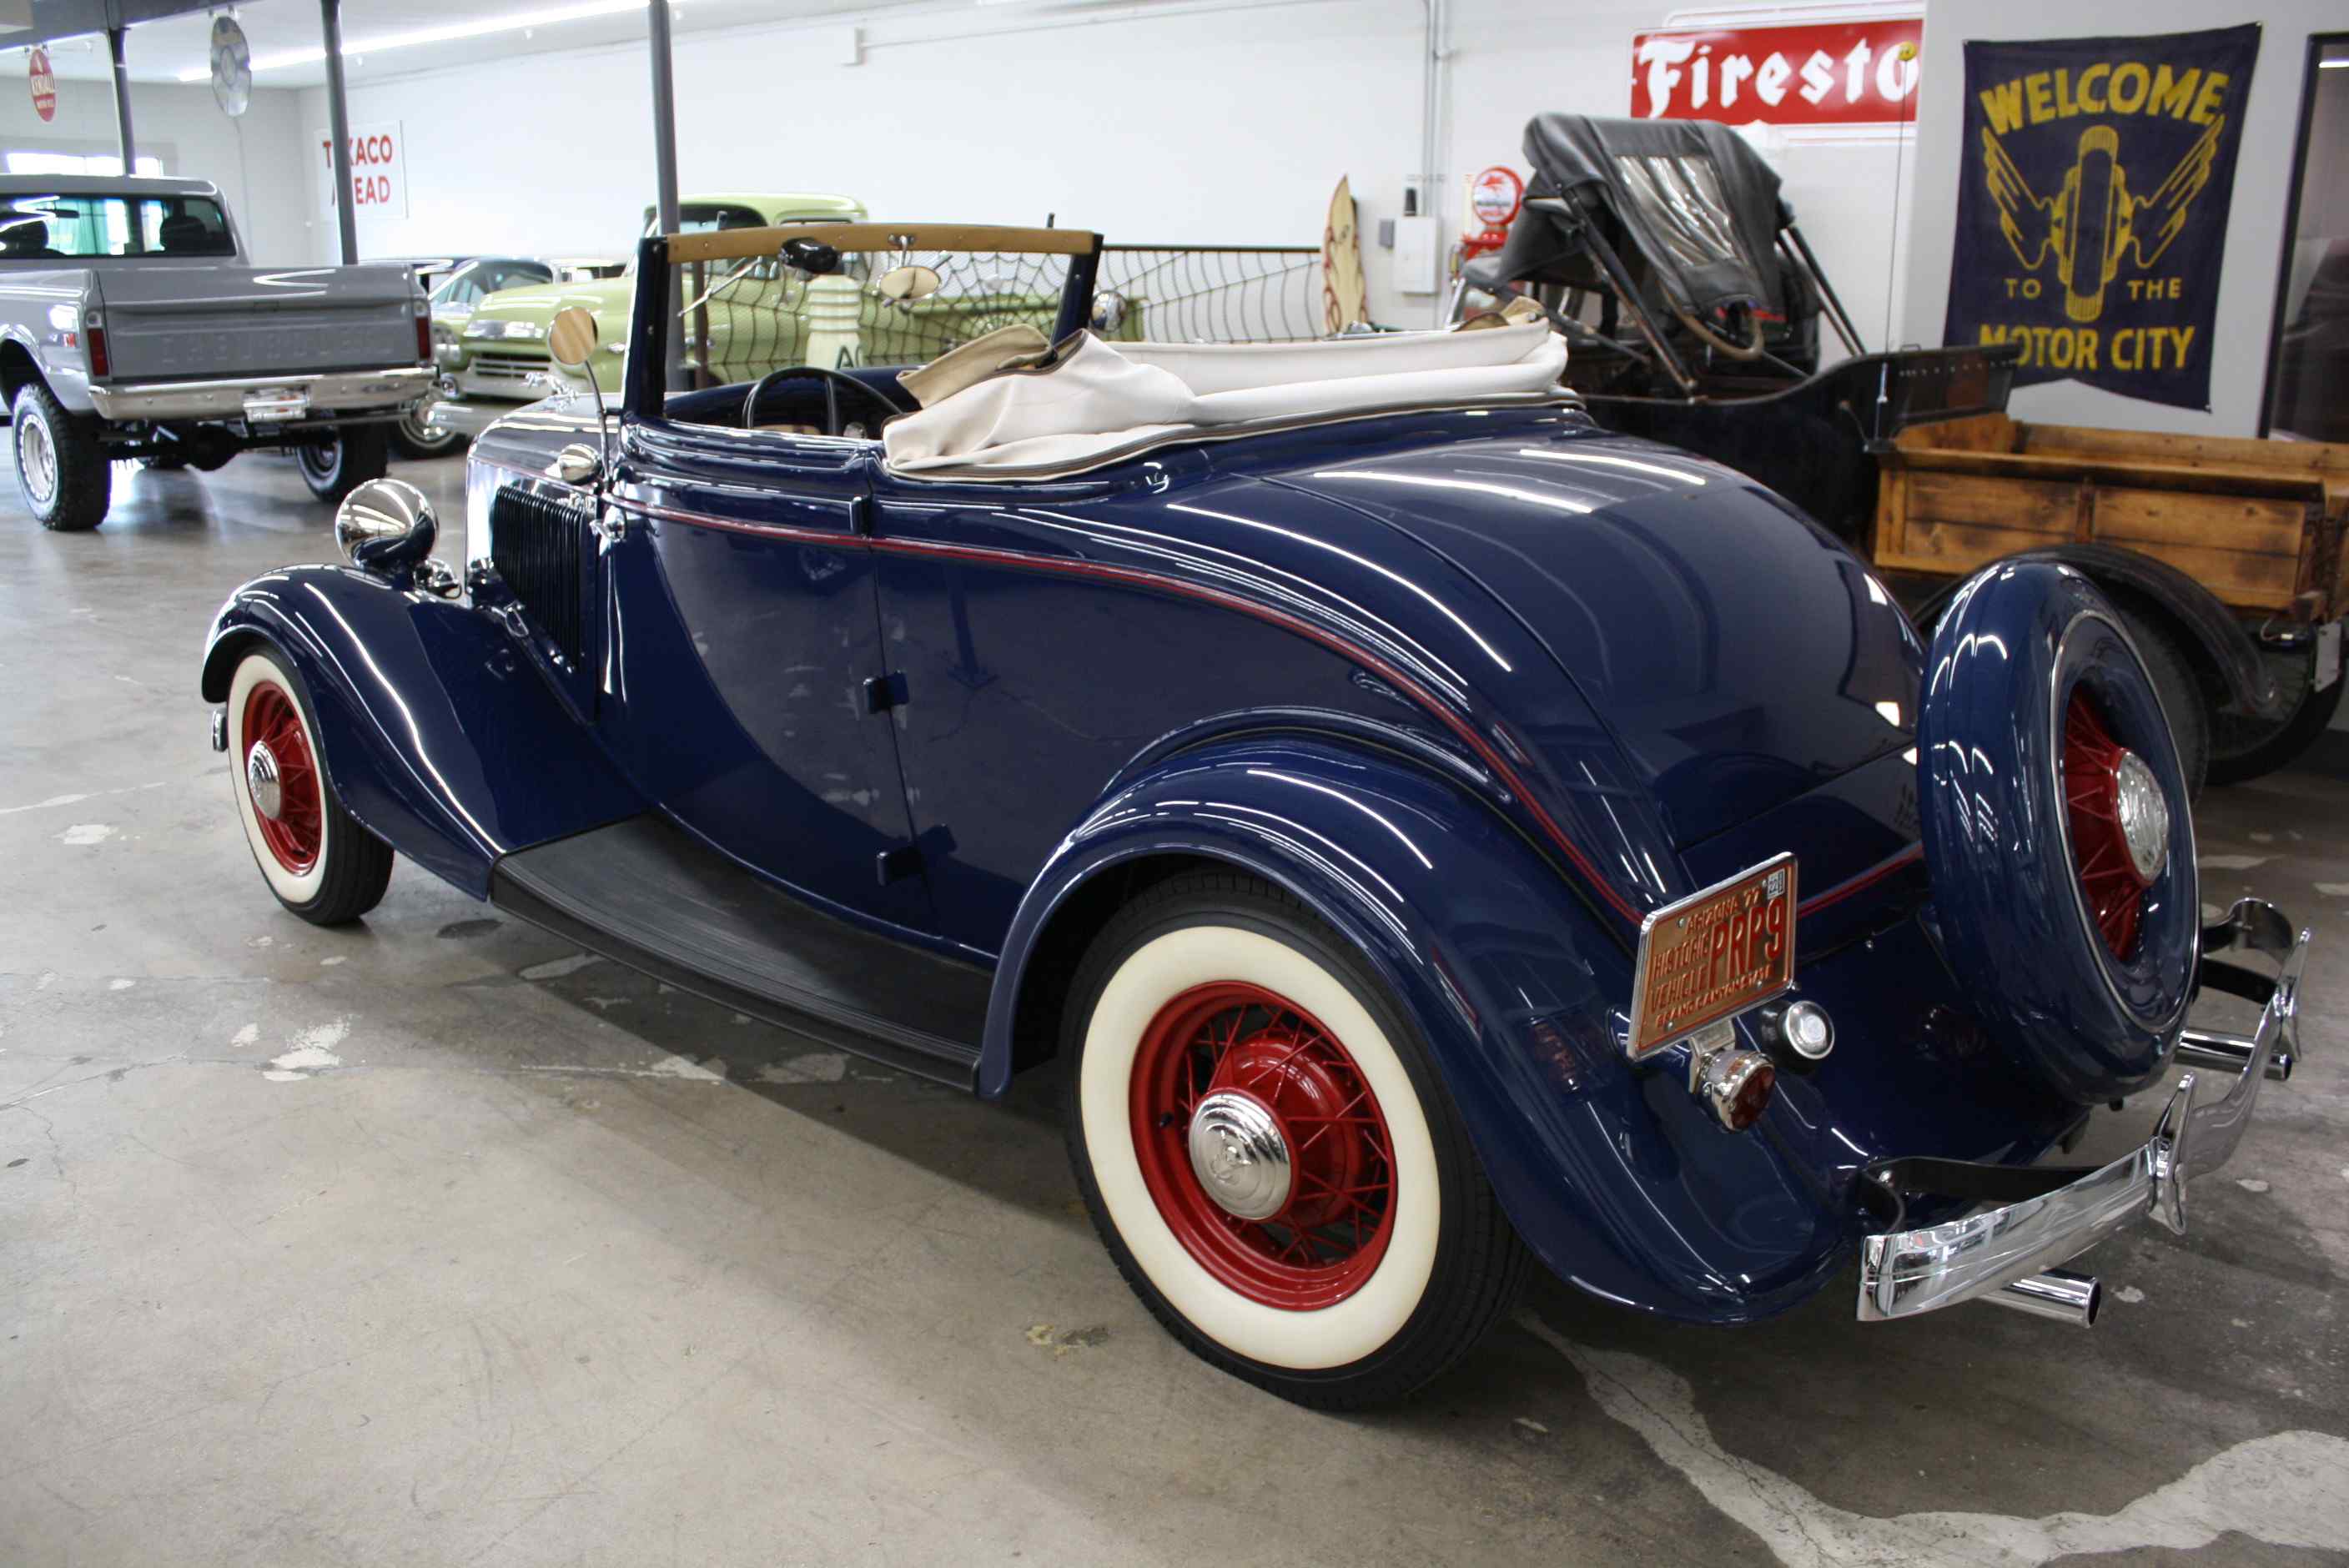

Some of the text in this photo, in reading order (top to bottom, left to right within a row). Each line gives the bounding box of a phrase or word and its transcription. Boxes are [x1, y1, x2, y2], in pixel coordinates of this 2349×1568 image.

[1980, 63, 2229, 135] WELCOME
[323, 135, 392, 168] TACO
[2005, 278, 2181, 299] TO THE
[2111, 326, 2195, 369] CITY
[1686, 895, 1738, 935] ARIZONA
[1652, 932, 1709, 981] HISTORIC
[1708, 898, 1783, 990] PRP9
[1650, 964, 1708, 1014] VEHICLE
